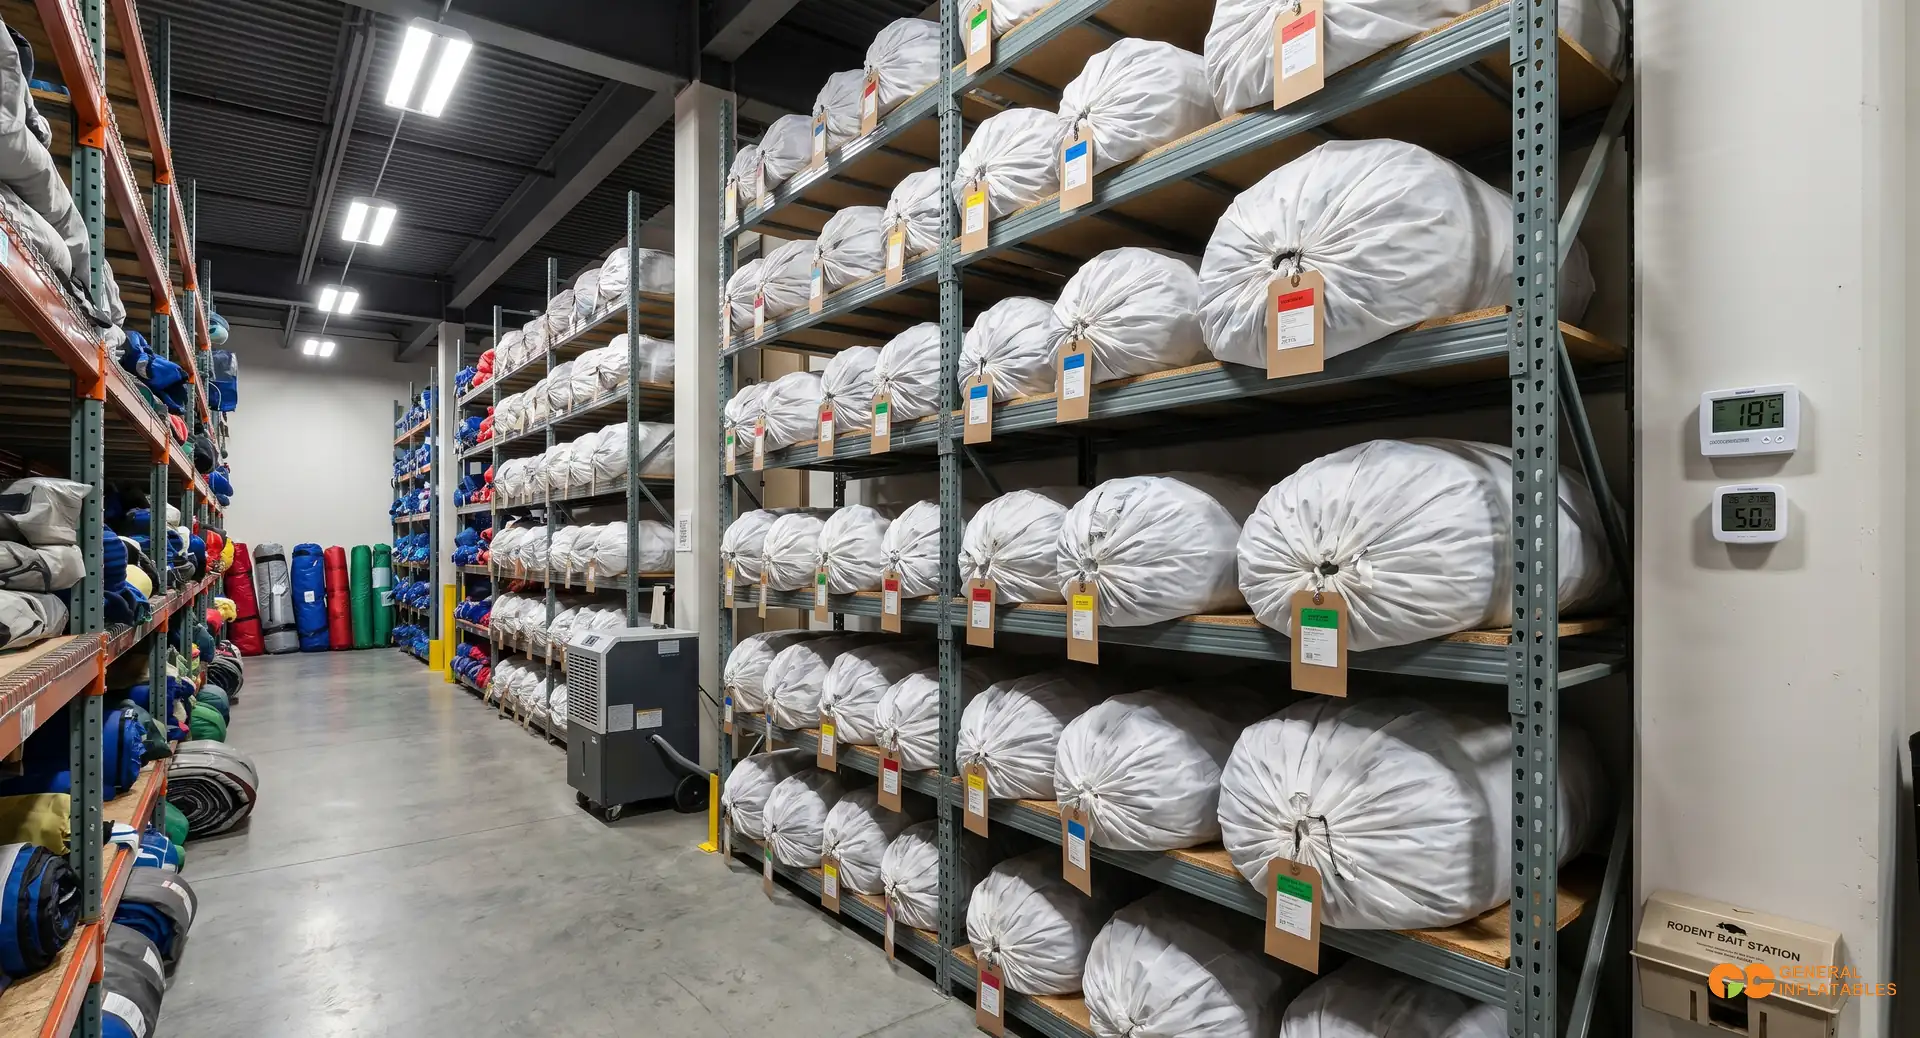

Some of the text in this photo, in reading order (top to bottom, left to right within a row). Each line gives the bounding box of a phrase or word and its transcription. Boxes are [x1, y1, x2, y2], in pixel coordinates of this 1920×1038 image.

[1667, 920, 1714, 939] RODENT
[1717, 933, 1745, 947] BAIT
[1747, 941, 1800, 961] STATION
